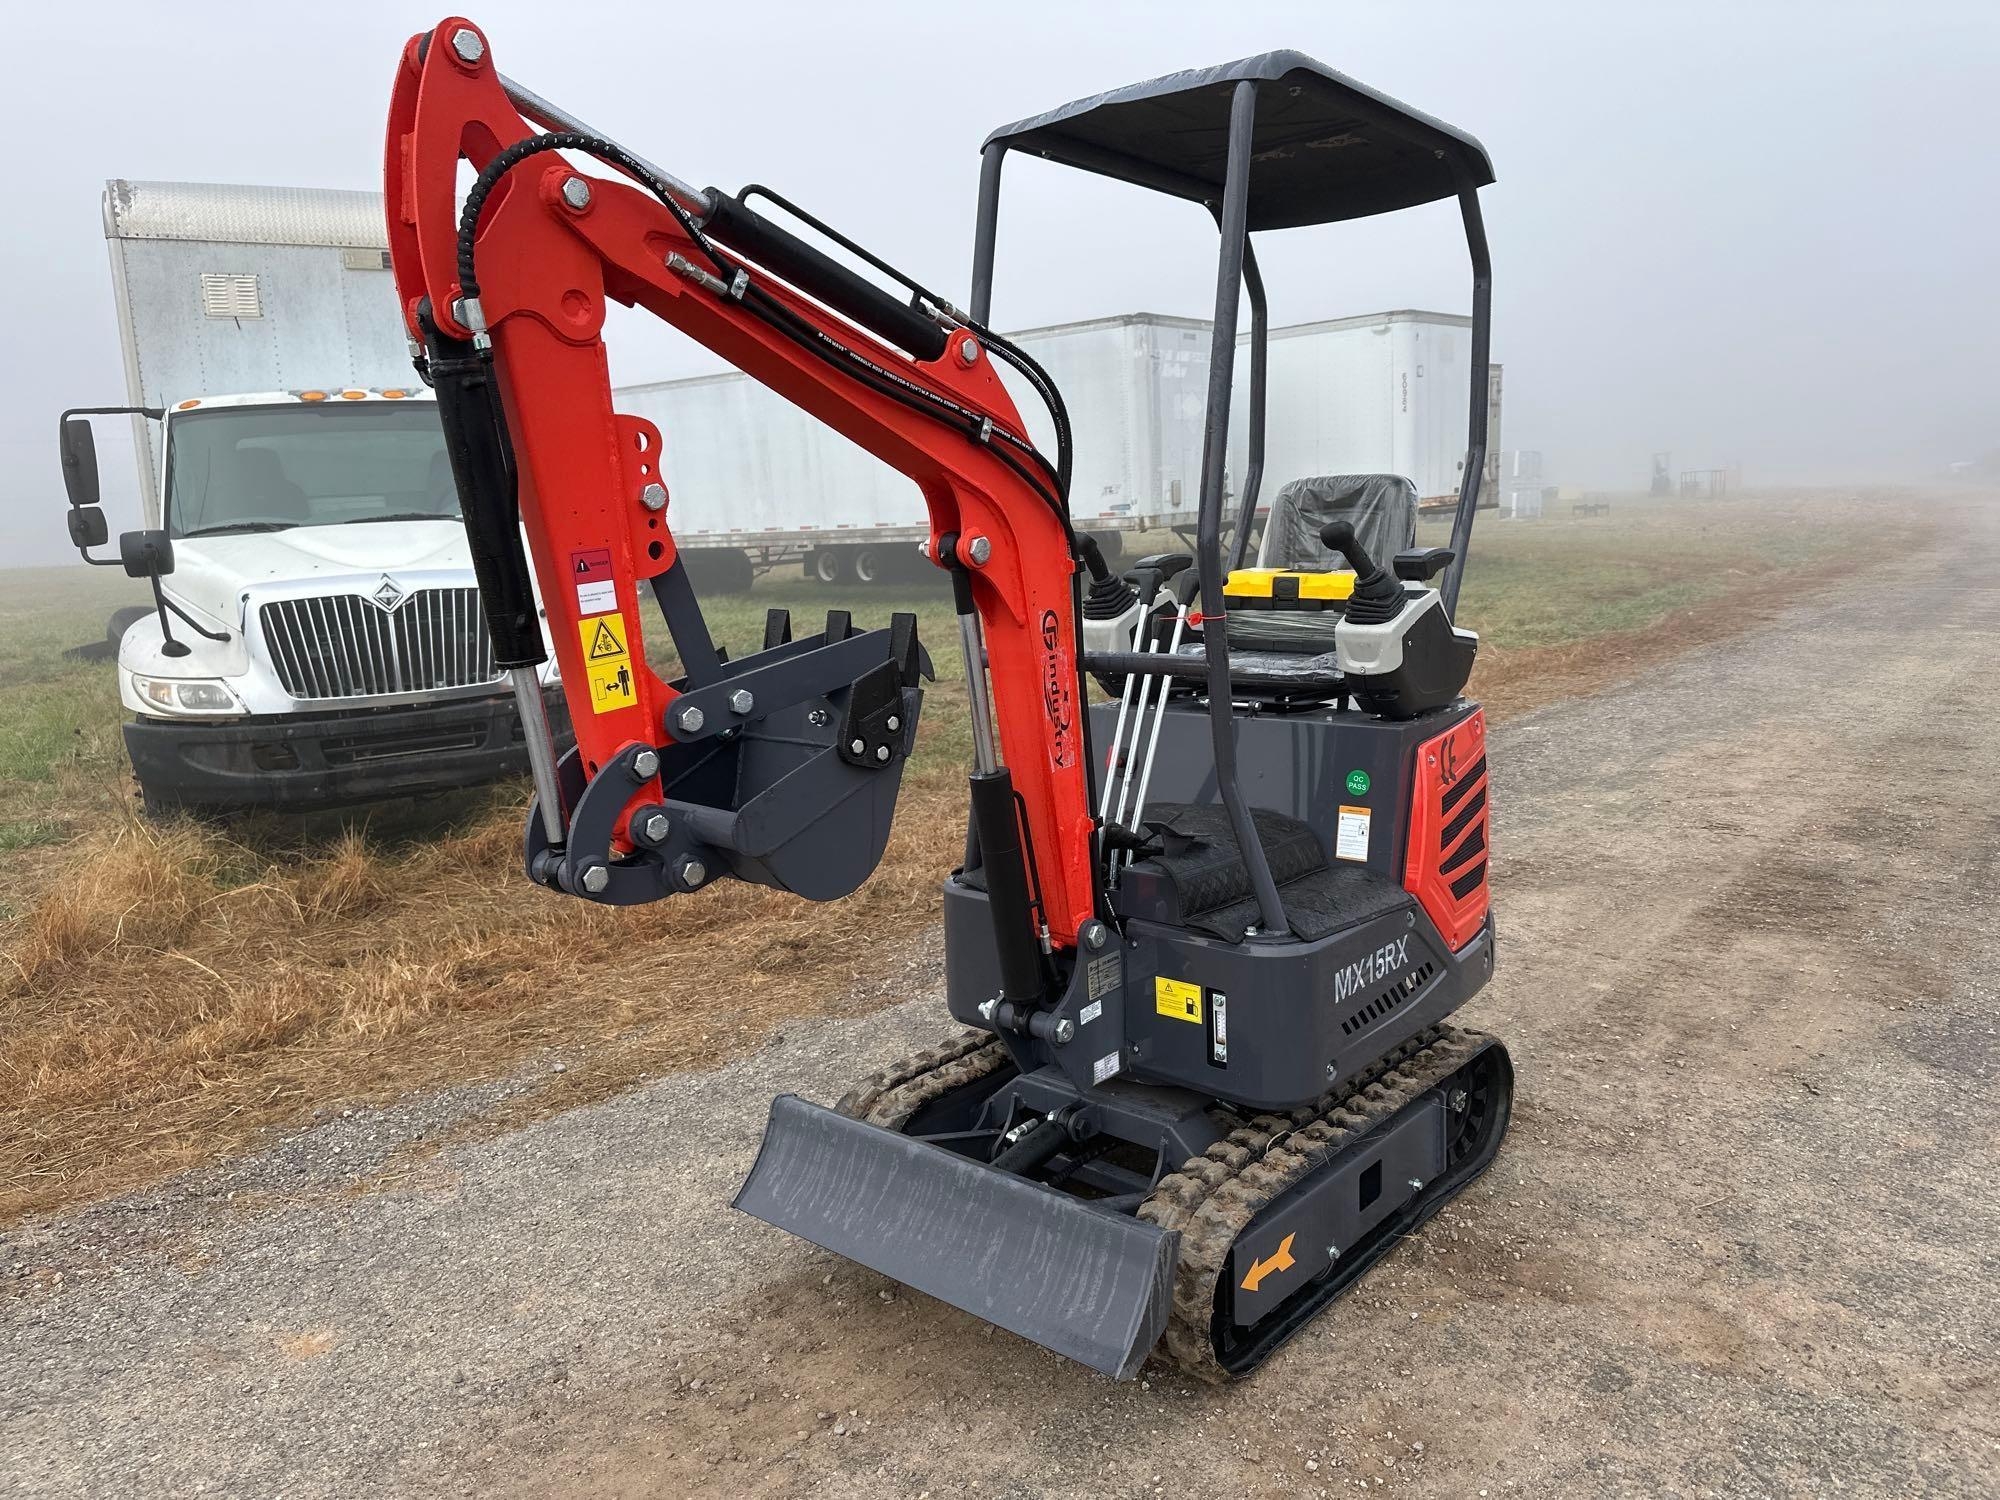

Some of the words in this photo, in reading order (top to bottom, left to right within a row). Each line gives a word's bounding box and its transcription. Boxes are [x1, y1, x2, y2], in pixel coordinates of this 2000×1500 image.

[1353, 775, 1364, 783] QC
[1348, 781, 1367, 791] PASS
[1334, 934, 1409, 1004] MX15RX
